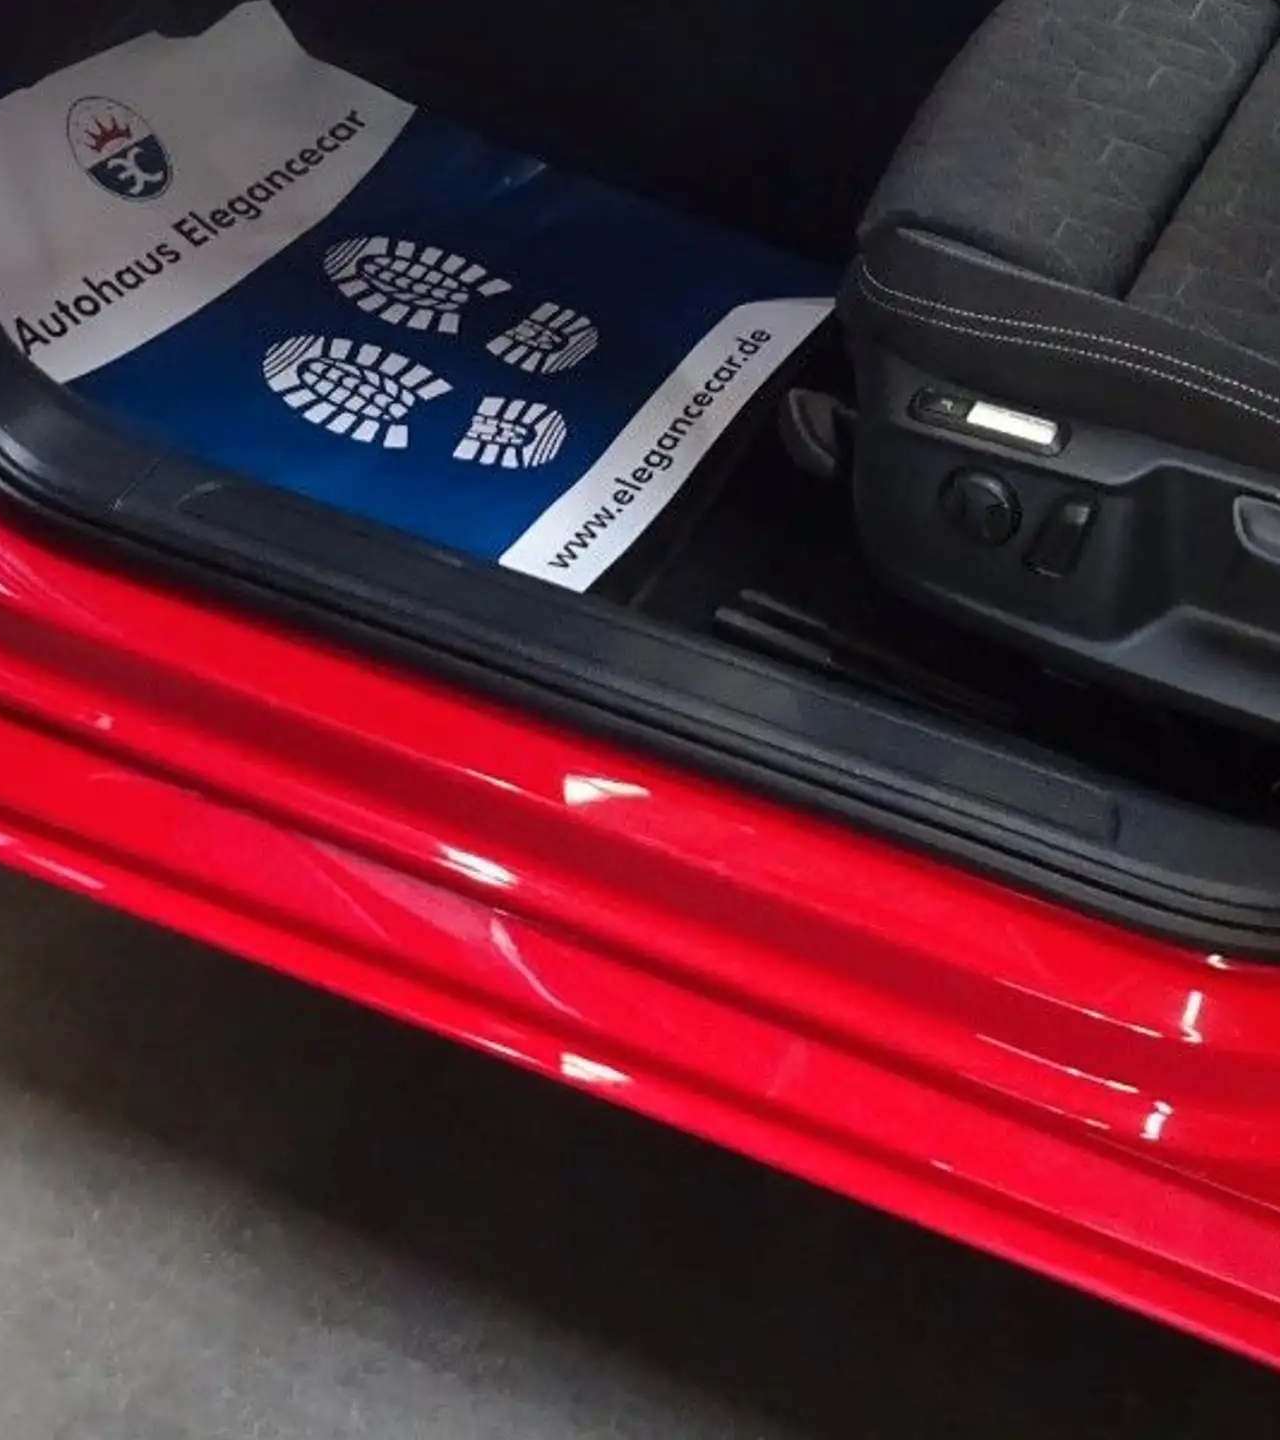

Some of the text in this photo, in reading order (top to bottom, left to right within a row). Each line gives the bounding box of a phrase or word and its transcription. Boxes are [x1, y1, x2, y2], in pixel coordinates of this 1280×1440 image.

[15, 109, 367, 356] Autohaus Elegancecar
[547, 328, 772, 570] www.elegancecar.de
